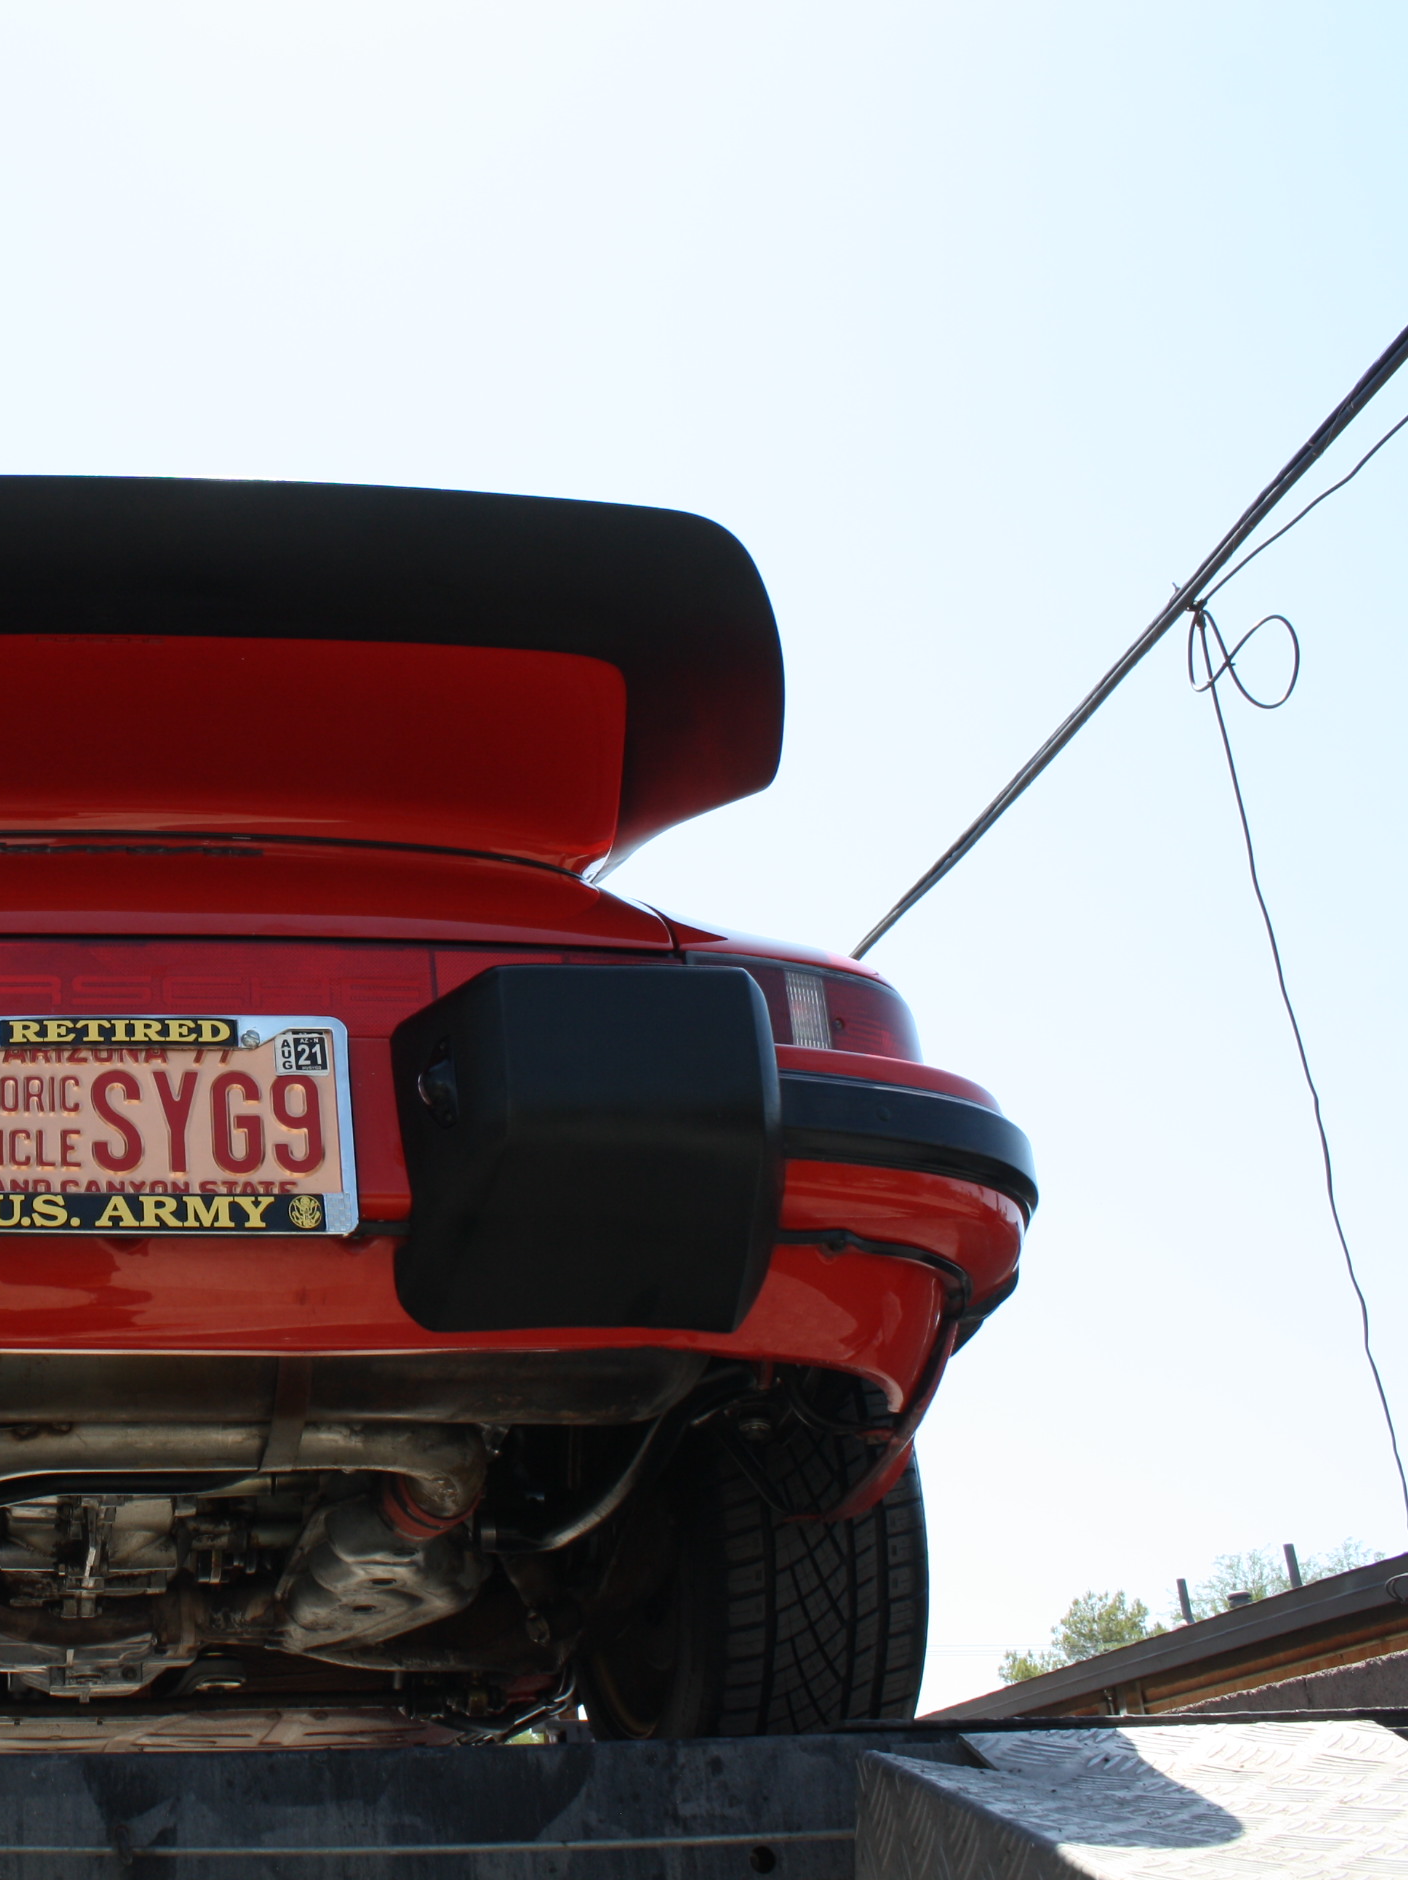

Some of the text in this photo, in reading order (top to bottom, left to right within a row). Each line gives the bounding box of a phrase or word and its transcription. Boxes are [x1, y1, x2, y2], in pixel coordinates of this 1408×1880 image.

[9, 1019, 232, 1044] RETIRED
[281, 1039, 293, 1070] AUG
[297, 1044, 322, 1065] 21
[90, 1069, 325, 1174] SYG9
[60, 1179, 189, 1193] CANYON
[198, 1180, 297, 1194] STATE
[95, 1195, 275, 1228] ARMY
